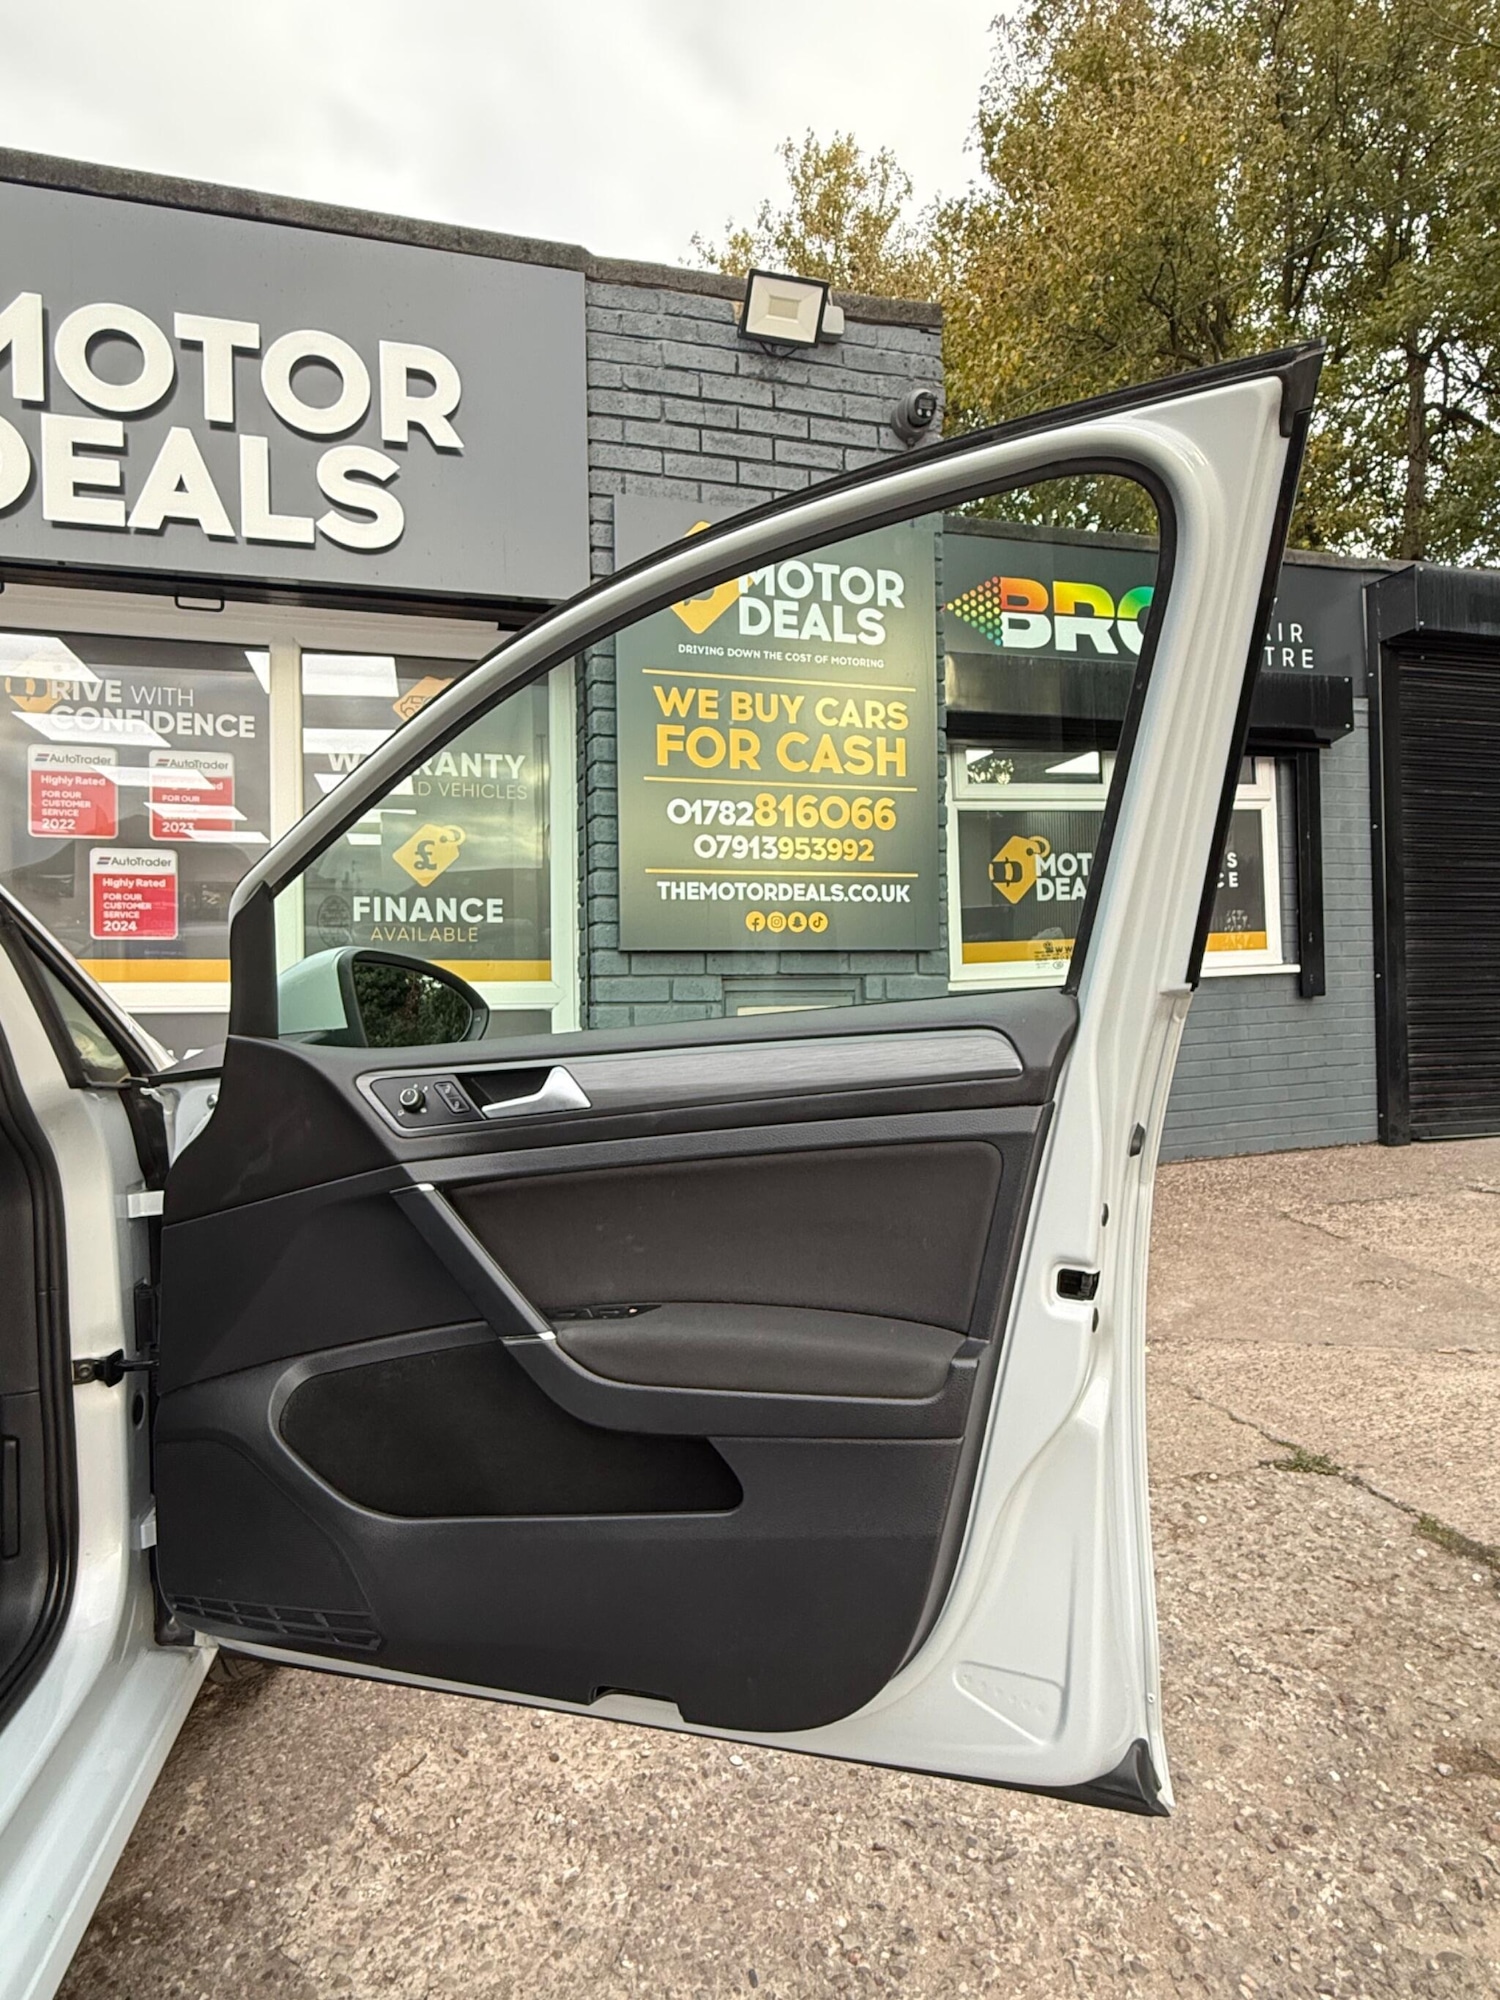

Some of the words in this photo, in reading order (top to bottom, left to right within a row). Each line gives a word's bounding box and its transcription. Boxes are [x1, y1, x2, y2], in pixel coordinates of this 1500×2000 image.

[738, 560, 905, 608] MOTOR
[739, 597, 886, 645] DEALS
[678, 644, 724, 656] DRIVING
[727, 648, 760, 659] DOWN
[763, 651, 783, 661] THE
[785, 652, 812, 663] COST
[814, 654, 828, 663] OF
[831, 655, 884, 668] MOTORING
[130, 685, 194, 707] WITH
[653, 686, 719, 719] WE
[731, 691, 805, 724] BUY
[815, 697, 909, 731] CARS
[656, 724, 761, 771] FOR
[776, 731, 906, 777] CASH
[50, 754, 111, 765] AutoTrader
[169, 759, 229, 770] AutoTrader
[327, 752, 526, 780] WRANTY
[41, 775, 73, 787] Highly
[75, 776, 106, 786] Rated
[42, 790, 61, 798] FOR
[438, 782, 528, 799] VEHICLES
[42, 799, 91, 808] CUSTOMER
[162, 794, 180, 802] FOR
[42, 808, 79, 817] SERVICE
[666, 793, 897, 831] 01782816066
[42, 818, 75, 830] 2022
[162, 822, 194, 833] 2023
[693, 834, 875, 862] 07913953992
[111, 857, 171, 867] AutoTrader
[102, 878, 135, 888] Highly
[136, 879, 166, 888] Rated
[122, 893, 142, 901] OUR
[656, 881, 911, 903] THEMOTORDEALS.CO.UK
[103, 901, 152, 910] CUSTOMER
[353, 896, 504, 923] FINANCE
[103, 911, 139, 919] SERVICE
[103, 921, 137, 932] 2024
[370, 926, 479, 942] AVAILABLE
